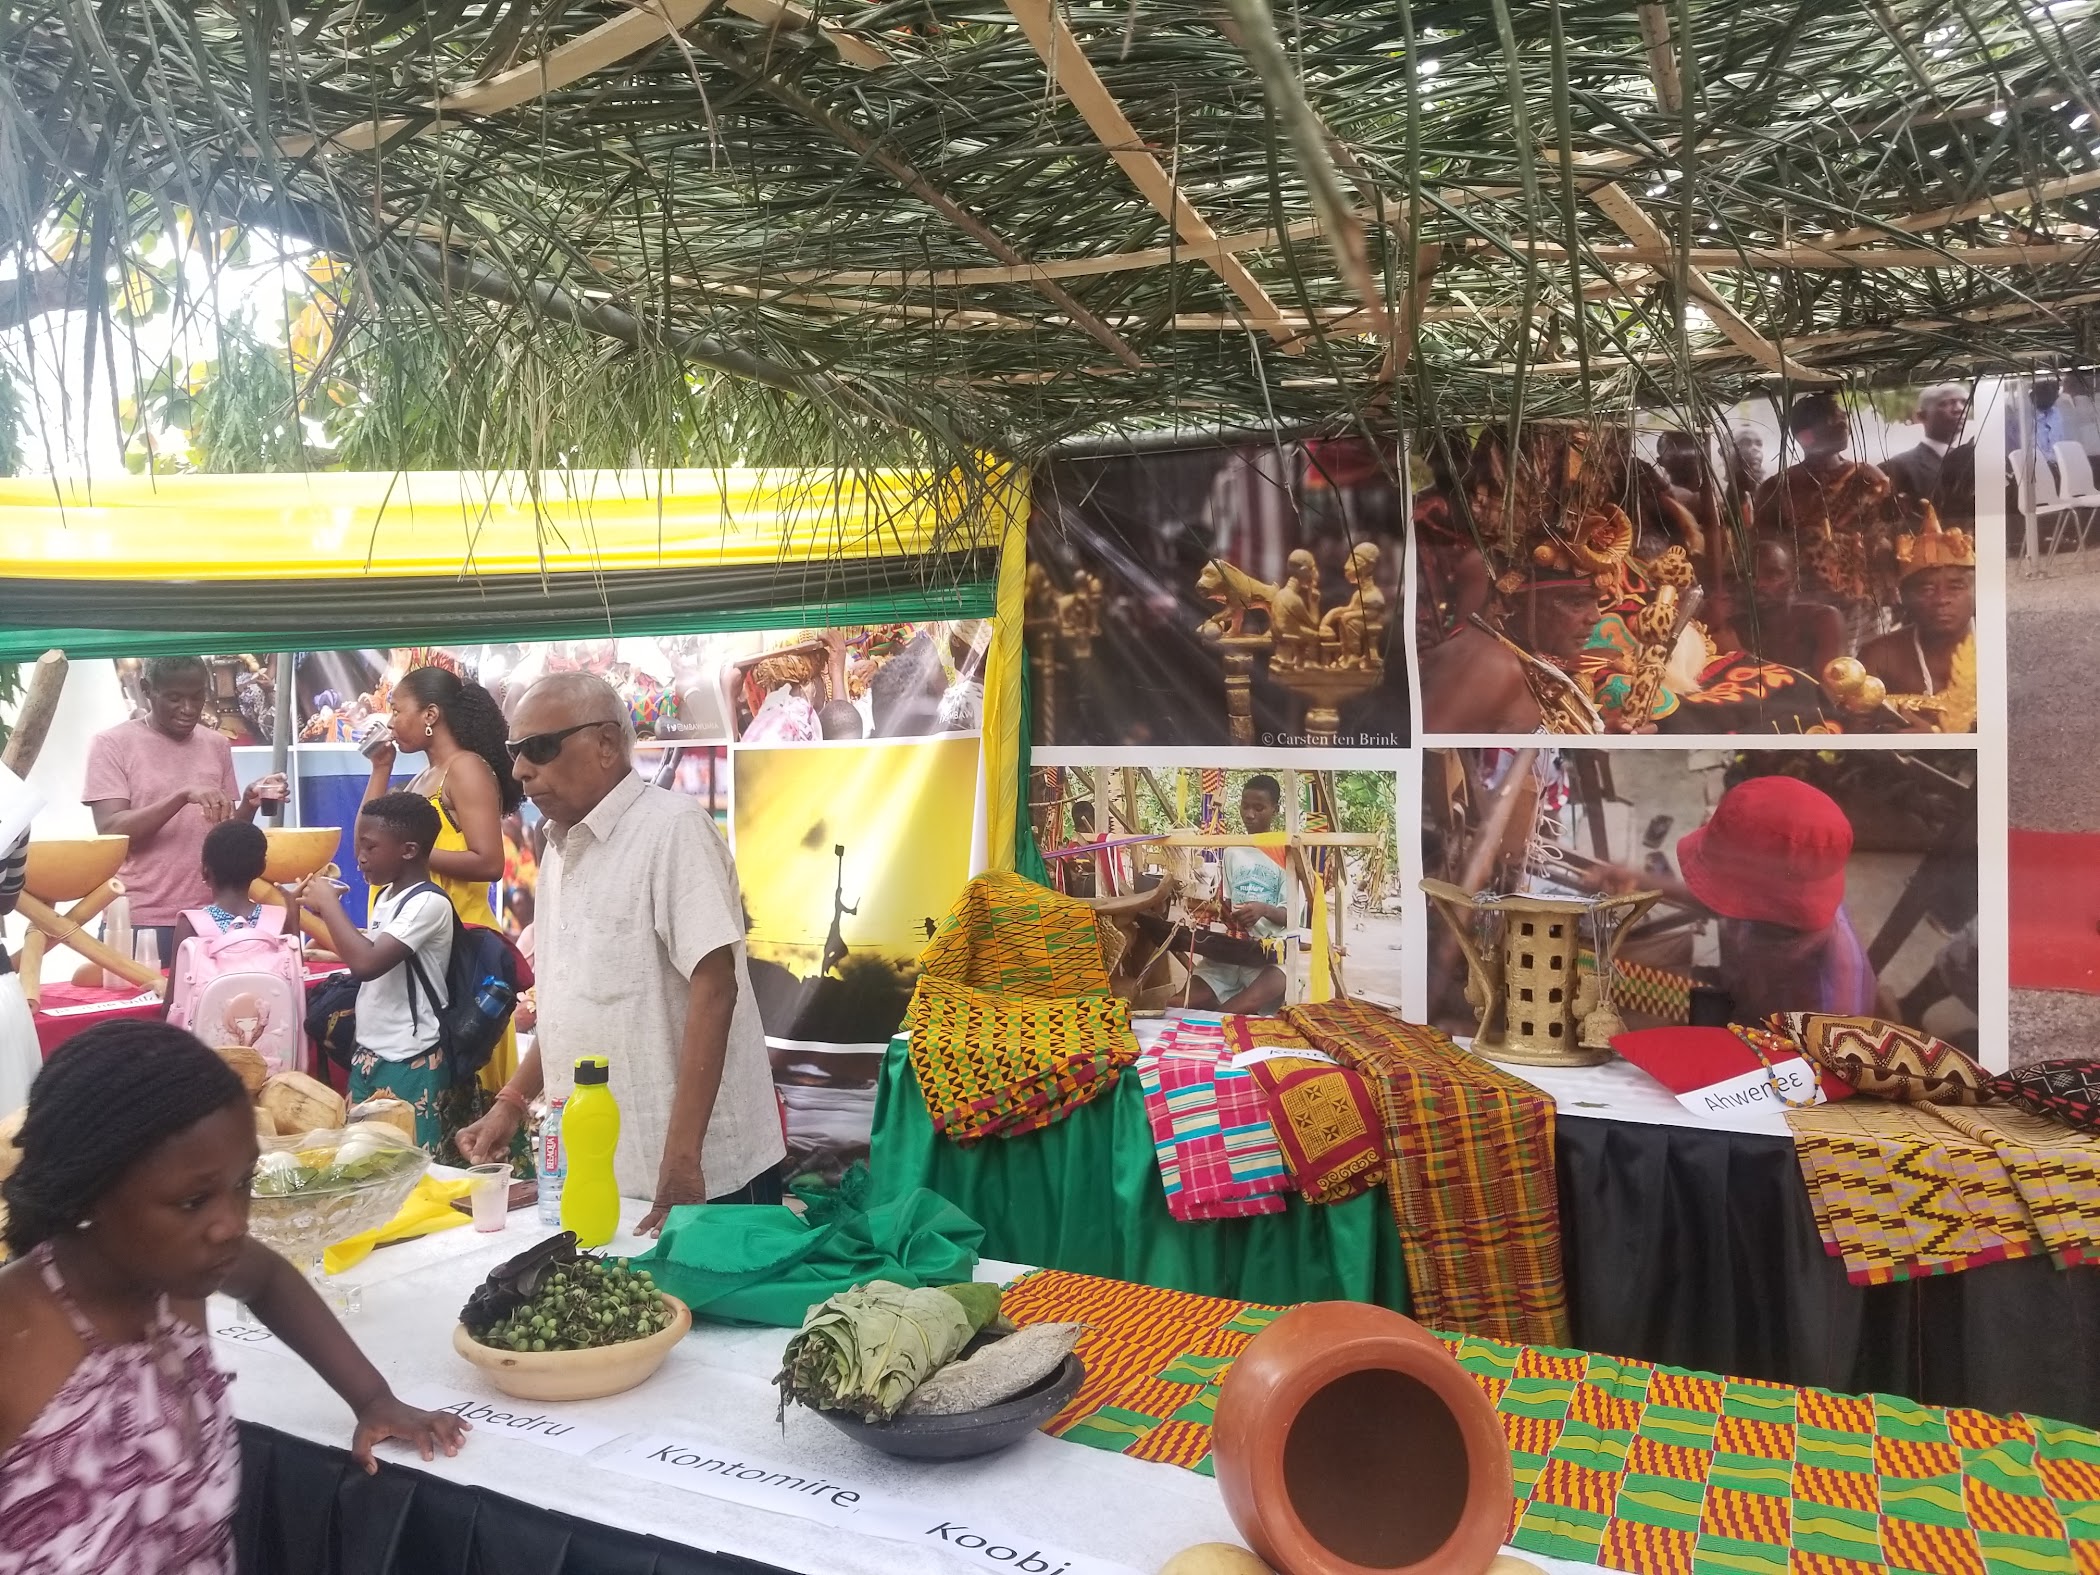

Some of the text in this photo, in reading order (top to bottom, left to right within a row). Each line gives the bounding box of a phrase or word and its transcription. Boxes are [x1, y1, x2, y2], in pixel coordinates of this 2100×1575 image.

[1276, 732, 1329, 746] Carsten
[1332, 732, 1354, 746] ten
[1359, 732, 1398, 746] Brink
[439, 1401, 576, 1437] Abedru
[646, 1445, 861, 1508] Kontomire
[925, 1521, 1072, 1575] Koobi
